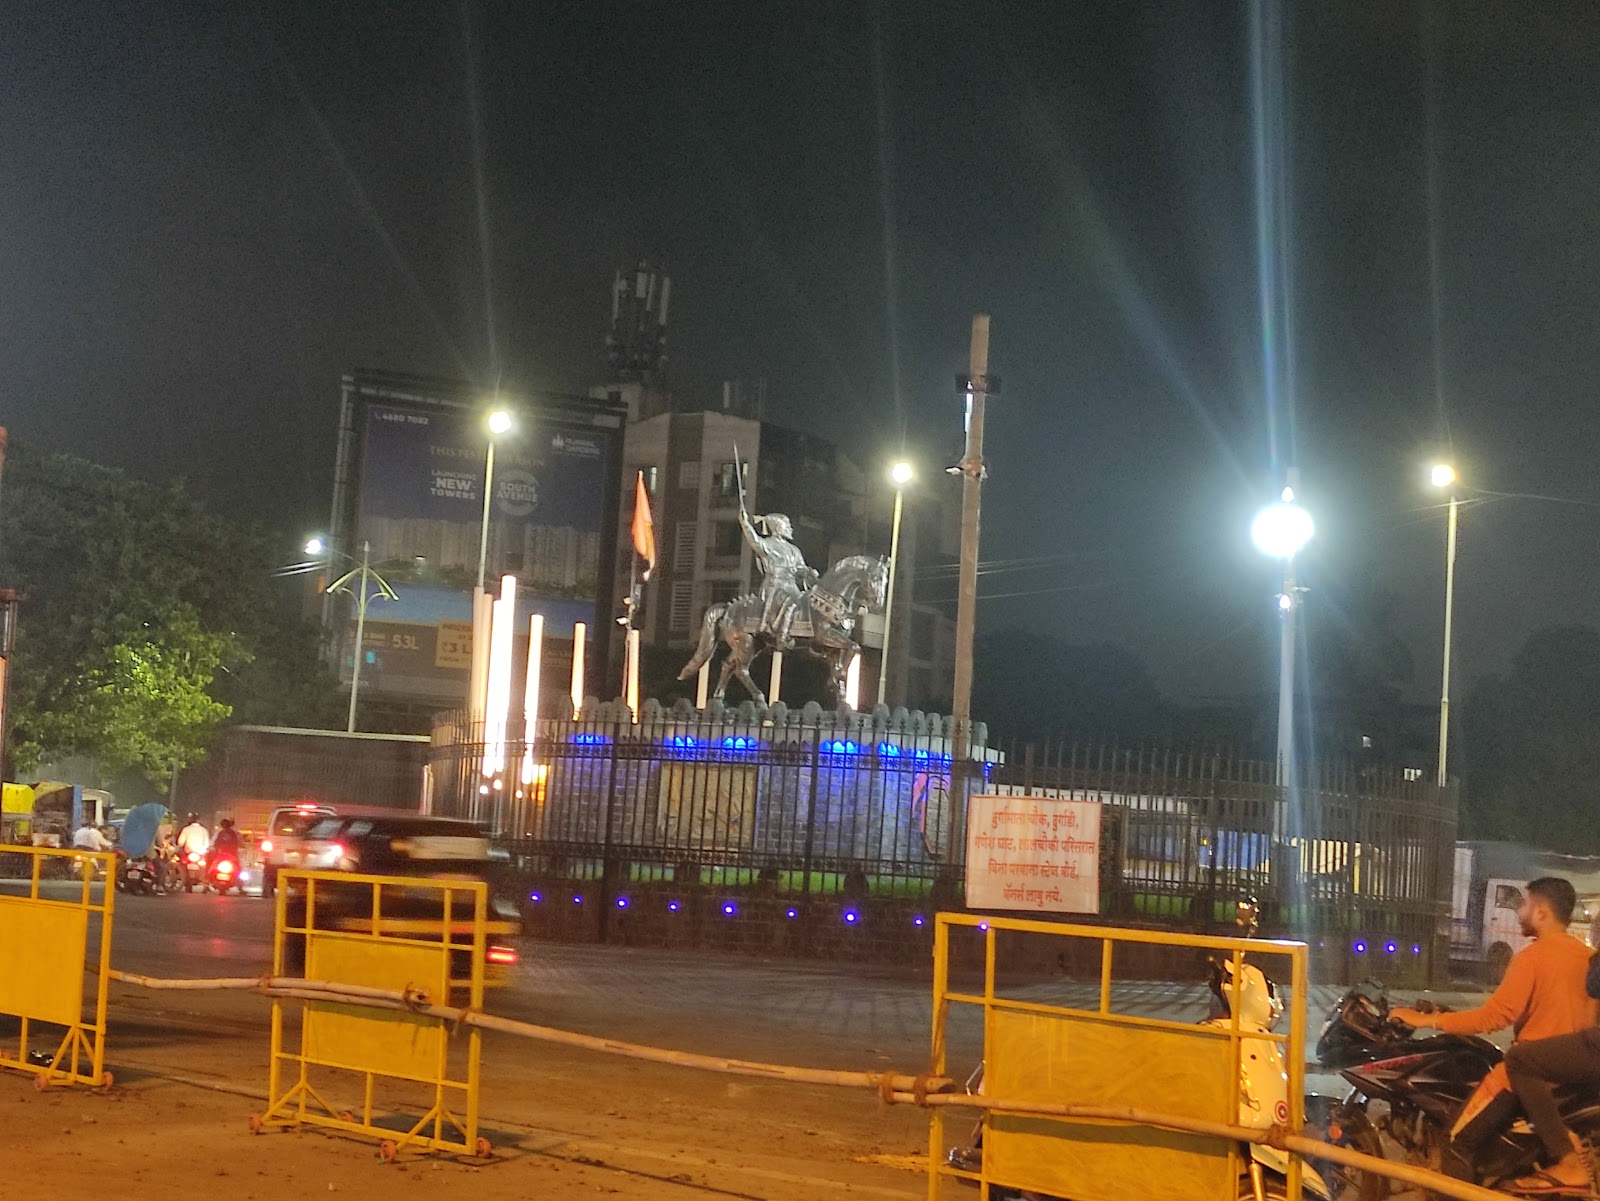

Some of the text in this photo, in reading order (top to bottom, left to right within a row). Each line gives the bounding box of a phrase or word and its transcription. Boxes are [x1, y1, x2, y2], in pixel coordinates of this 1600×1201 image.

[436, 477, 473, 491] NEW
[499, 481, 536, 493] SOUTH
[430, 487, 475, 500] TOWERS
[496, 490, 539, 503] AVENUE
[392, 634, 419, 650] 53L
[1060, 836, 1095, 854] परिसरात
